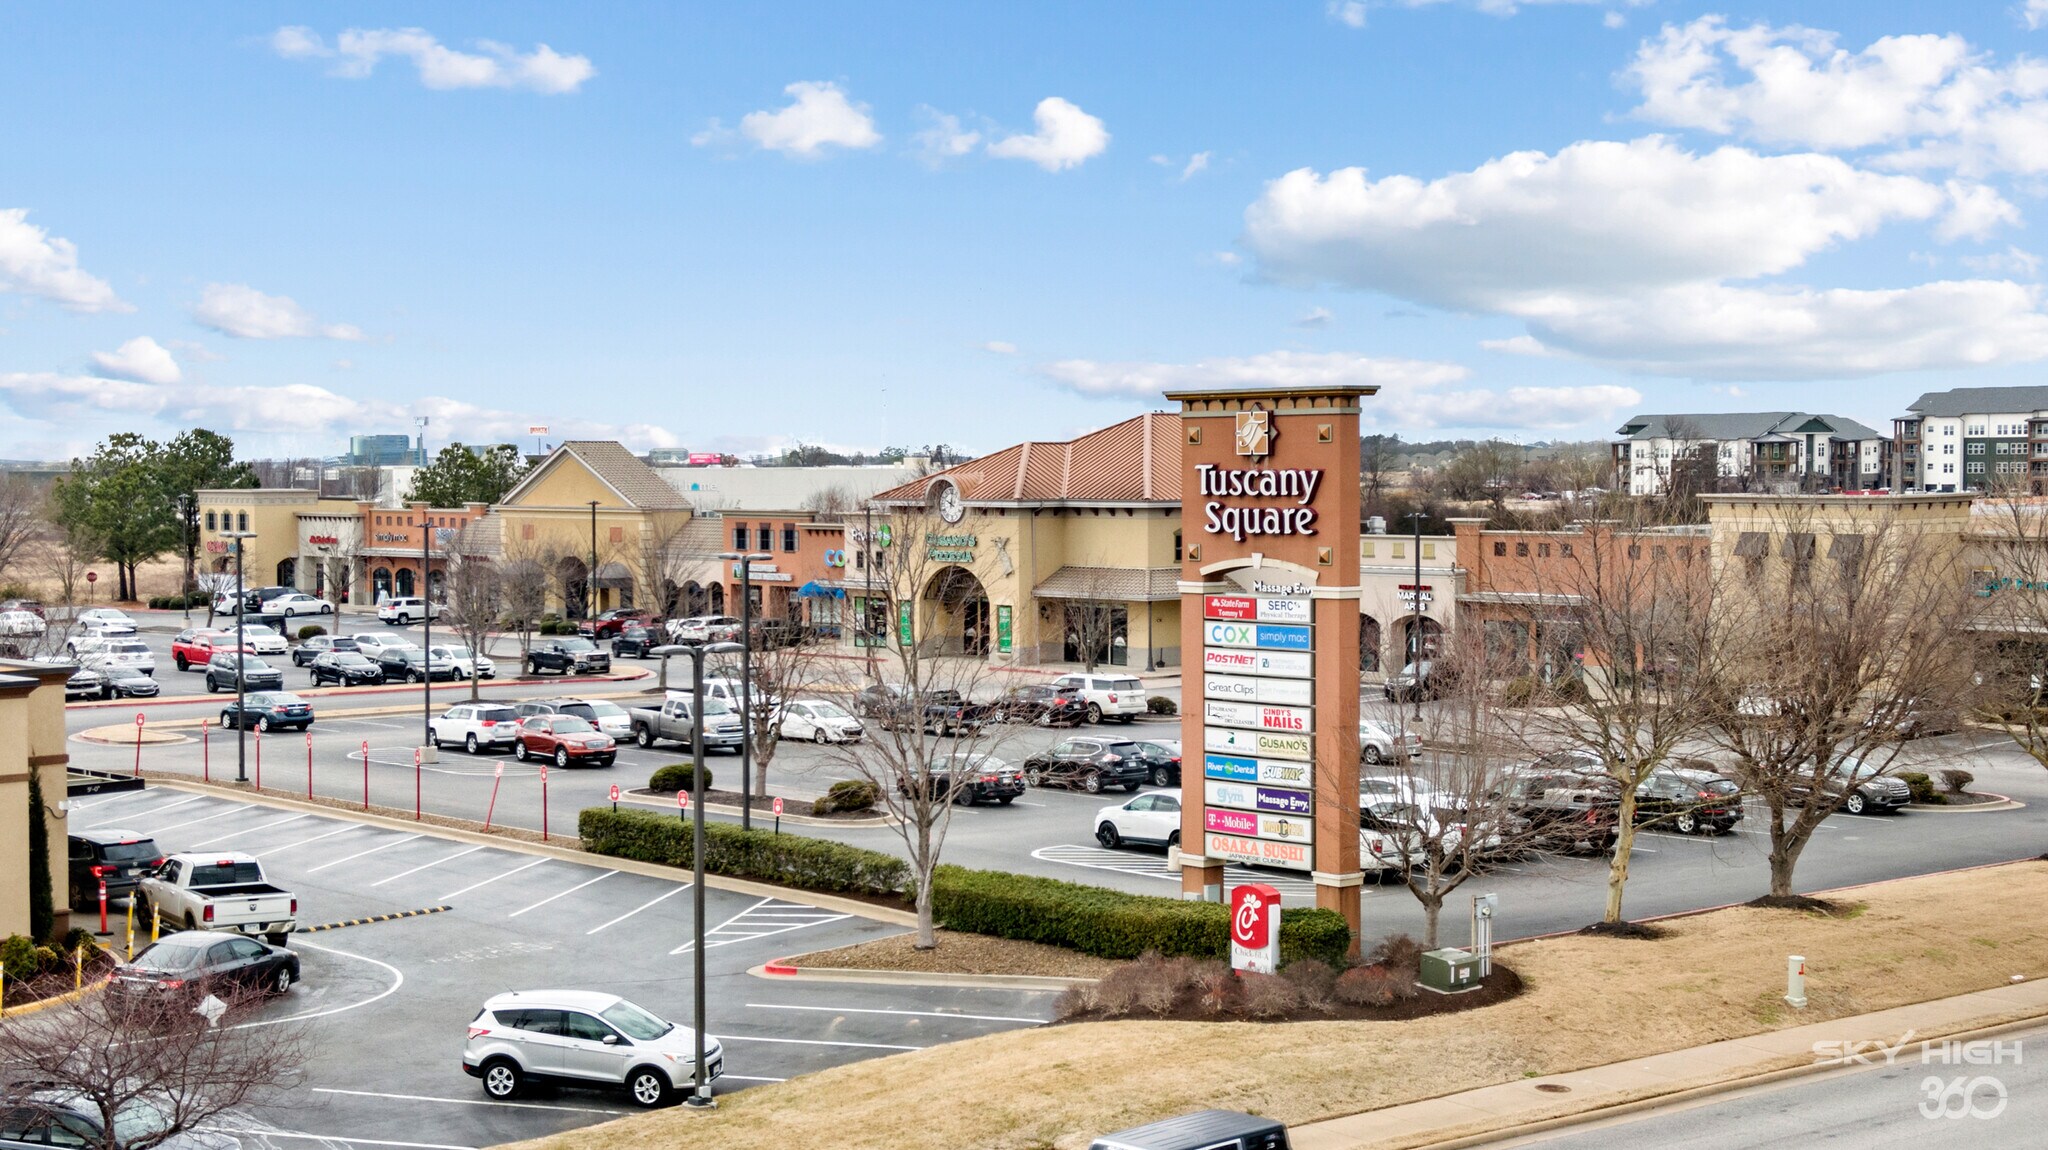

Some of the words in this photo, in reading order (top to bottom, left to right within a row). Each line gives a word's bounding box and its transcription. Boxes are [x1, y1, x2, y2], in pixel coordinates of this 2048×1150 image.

[1194, 463, 1319, 504] Tuscany
[1203, 501, 1315, 541] Square
[1253, 581, 1292, 597] Massage
[1268, 600, 1294, 611] SERC
[1404, 602, 1426, 611] ARS
[1218, 609, 1239, 618] Tommy
[1211, 625, 1250, 643] COX
[1260, 632, 1287, 643] simply
[1288, 634, 1308, 643] mac
[1208, 681, 1232, 693] Great
[1233, 683, 1255, 696] Clips
[1263, 708, 1292, 717] CINDY'S
[1263, 716, 1303, 730] NAILS
[1259, 736, 1308, 752] GUSANO'S
[1207, 762, 1225, 772] River
[1233, 764, 1256, 775] Dental
[1263, 765, 1305, 781] SUBWAY
[1258, 792, 1289, 809] Massage
[1211, 836, 1260, 856] OSAKA
[1263, 843, 1305, 862] SUSHI
